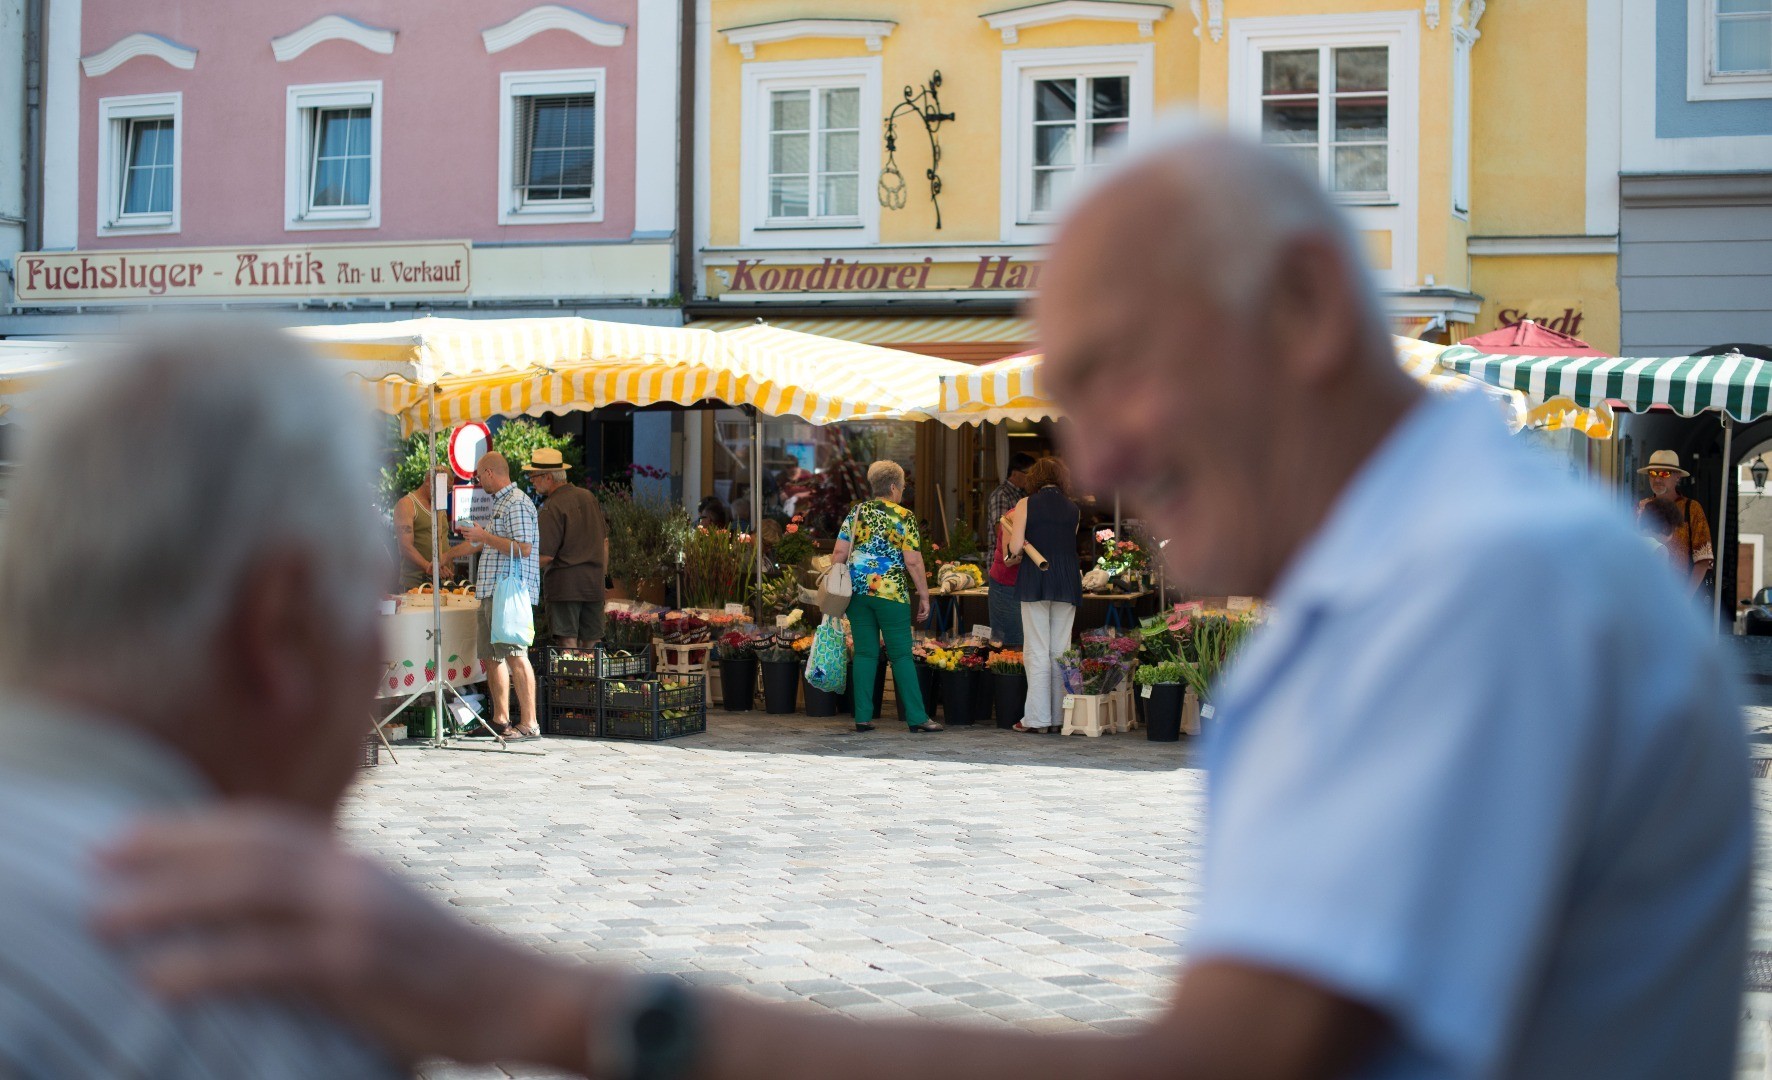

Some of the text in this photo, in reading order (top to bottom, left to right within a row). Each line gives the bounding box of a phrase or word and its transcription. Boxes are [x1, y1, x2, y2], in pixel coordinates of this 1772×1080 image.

[26, 257, 203, 295] Fuchsluger
[235, 252, 326, 286] Antik
[337, 262, 366, 284] An-
[371, 267, 385, 283] u.
[390, 259, 461, 283] Verkauf
[728, 257, 933, 291] Konditorei
